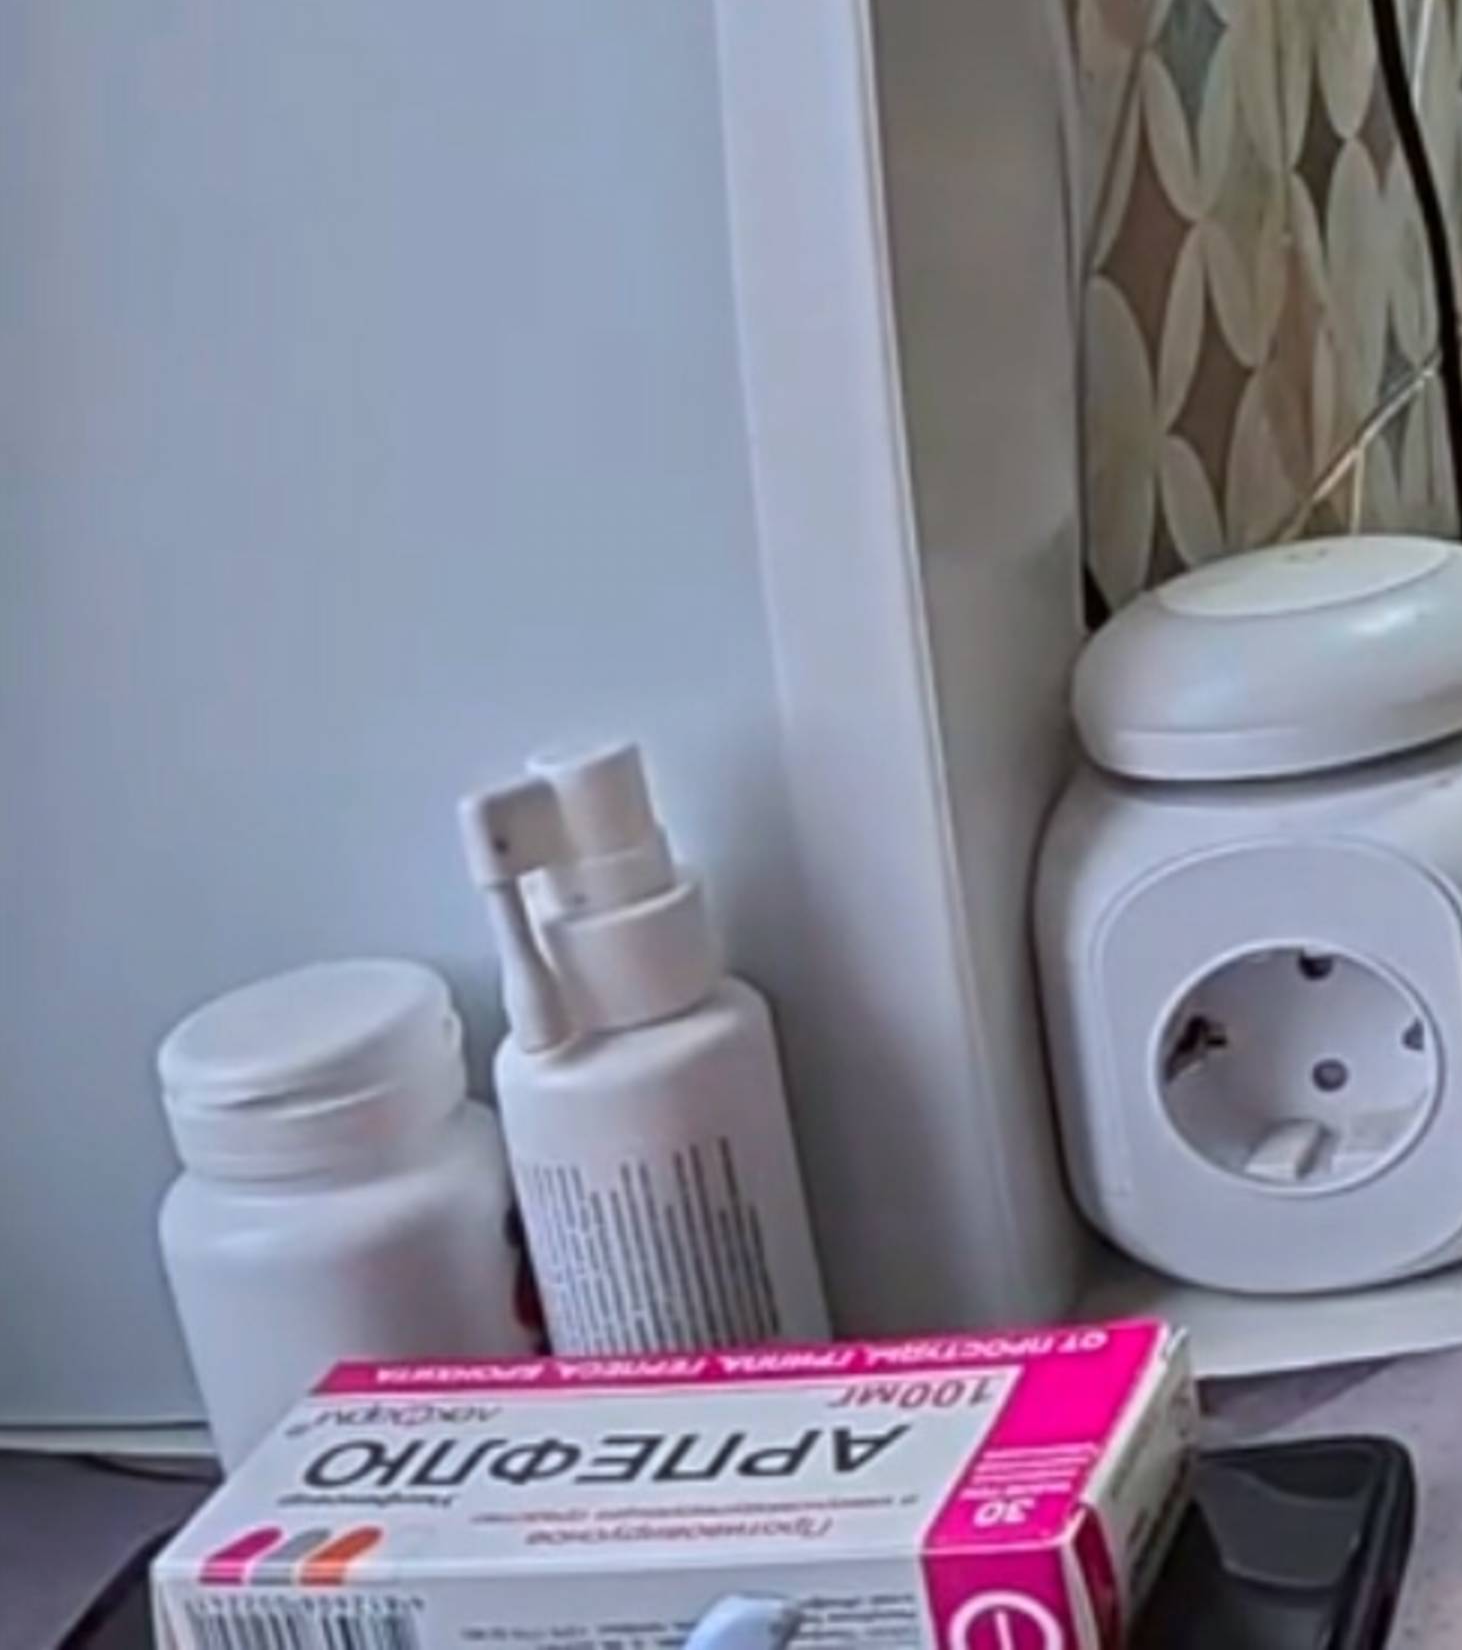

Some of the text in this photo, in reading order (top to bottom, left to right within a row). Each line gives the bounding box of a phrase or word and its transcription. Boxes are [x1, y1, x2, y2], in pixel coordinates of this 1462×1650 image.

[1058, 1331, 1108, 1351] ОТ
[303, 1423, 912, 1488] АРПЕФЛЮ
[973, 1498, 1036, 1527] 30
